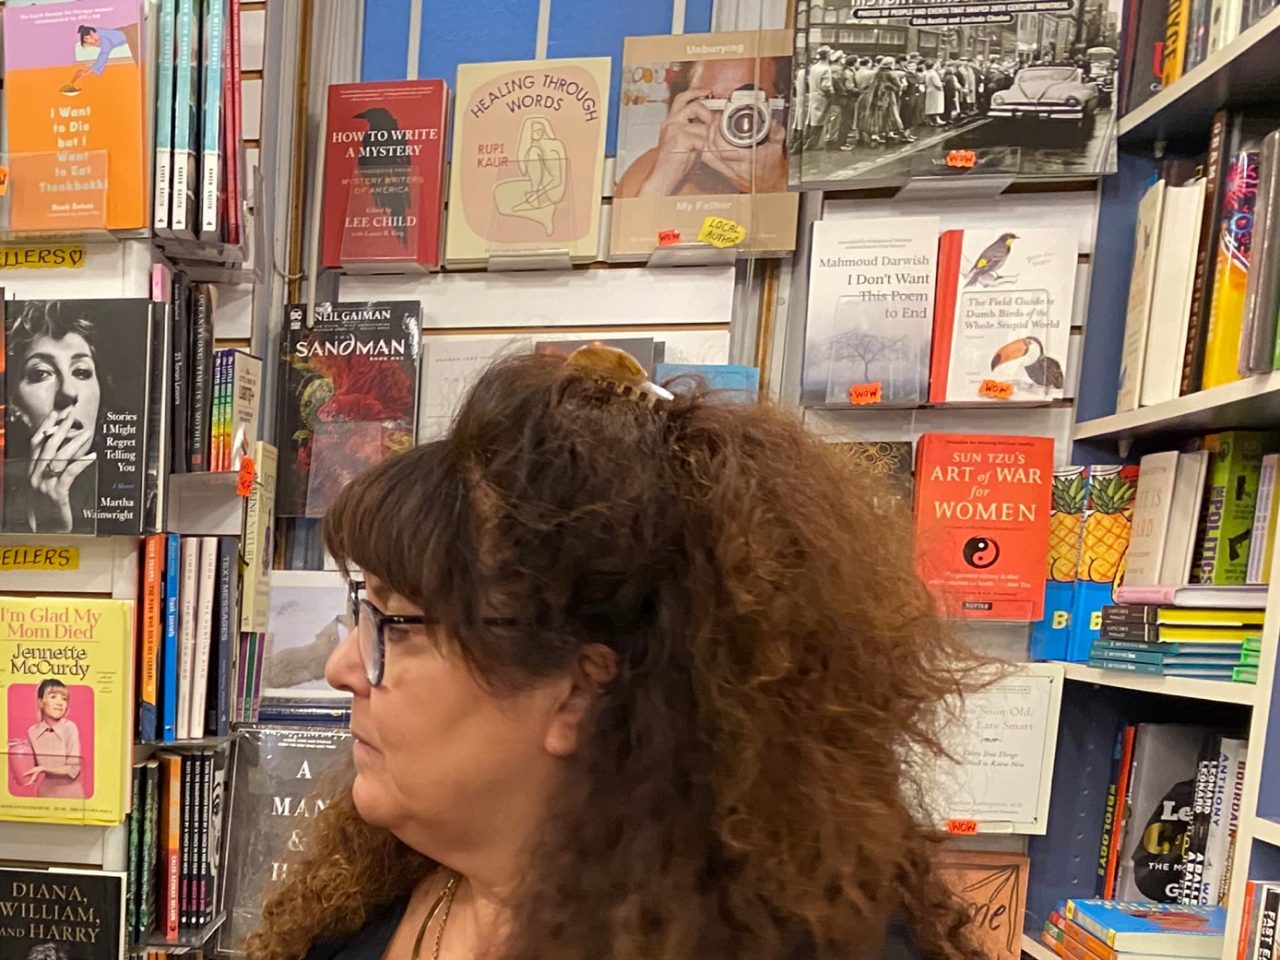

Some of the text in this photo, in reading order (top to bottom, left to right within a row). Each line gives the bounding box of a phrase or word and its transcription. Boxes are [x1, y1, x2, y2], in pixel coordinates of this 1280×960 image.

[471, 75, 599, 123] HEALING THROUGH
[506, 97, 564, 114] WORDS
[332, 128, 438, 143] HOW TO WRITE
[345, 144, 422, 157] A MYSTERY
[477, 144, 504, 155] RUPI
[477, 156, 508, 168] KAUR
[345, 216, 416, 228] LEE CHILD
[708, 219, 740, 234] LOCAL
[659, 232, 679, 243] WOW
[705, 231, 740, 245] AUTHOR
[820, 256, 929, 268] Mahmoud Darwish
[856, 274, 891, 285] Don't
[895, 274, 929, 284] Want
[859, 291, 928, 301] This Poem
[885, 308, 927, 318] to End
[296, 334, 406, 357] SANDMAN
[855, 390, 878, 398] WOW
[985, 384, 1009, 393] WOW
[107, 412, 137, 422] Stories
[111, 424, 136, 436] Might
[107, 437, 136, 449] Regret
[105, 449, 136, 462] Telling
[953, 452, 1026, 465] SUN TZU'S
[118, 462, 136, 472] You
[931, 467, 1042, 485] ART of WAR
[968, 485, 990, 498] for
[100, 498, 134, 507] Martha
[83, 509, 134, 521] Wainwright
[934, 502, 1036, 521] WOMEN
[0, 607, 101, 628] I'm Glad My
[8, 624, 94, 639] Mom Died
[13, 645, 87, 661] Jennette
[11, 659, 90, 680] McCurdy
[1211, 753, 1229, 827] ANTHONY
[1228, 761, 1246, 839] BOURDAIN
[12, 882, 87, 903] DIANA,
[0, 902, 101, 926] WILLIAM,
[29, 925, 100, 944] HARRY
